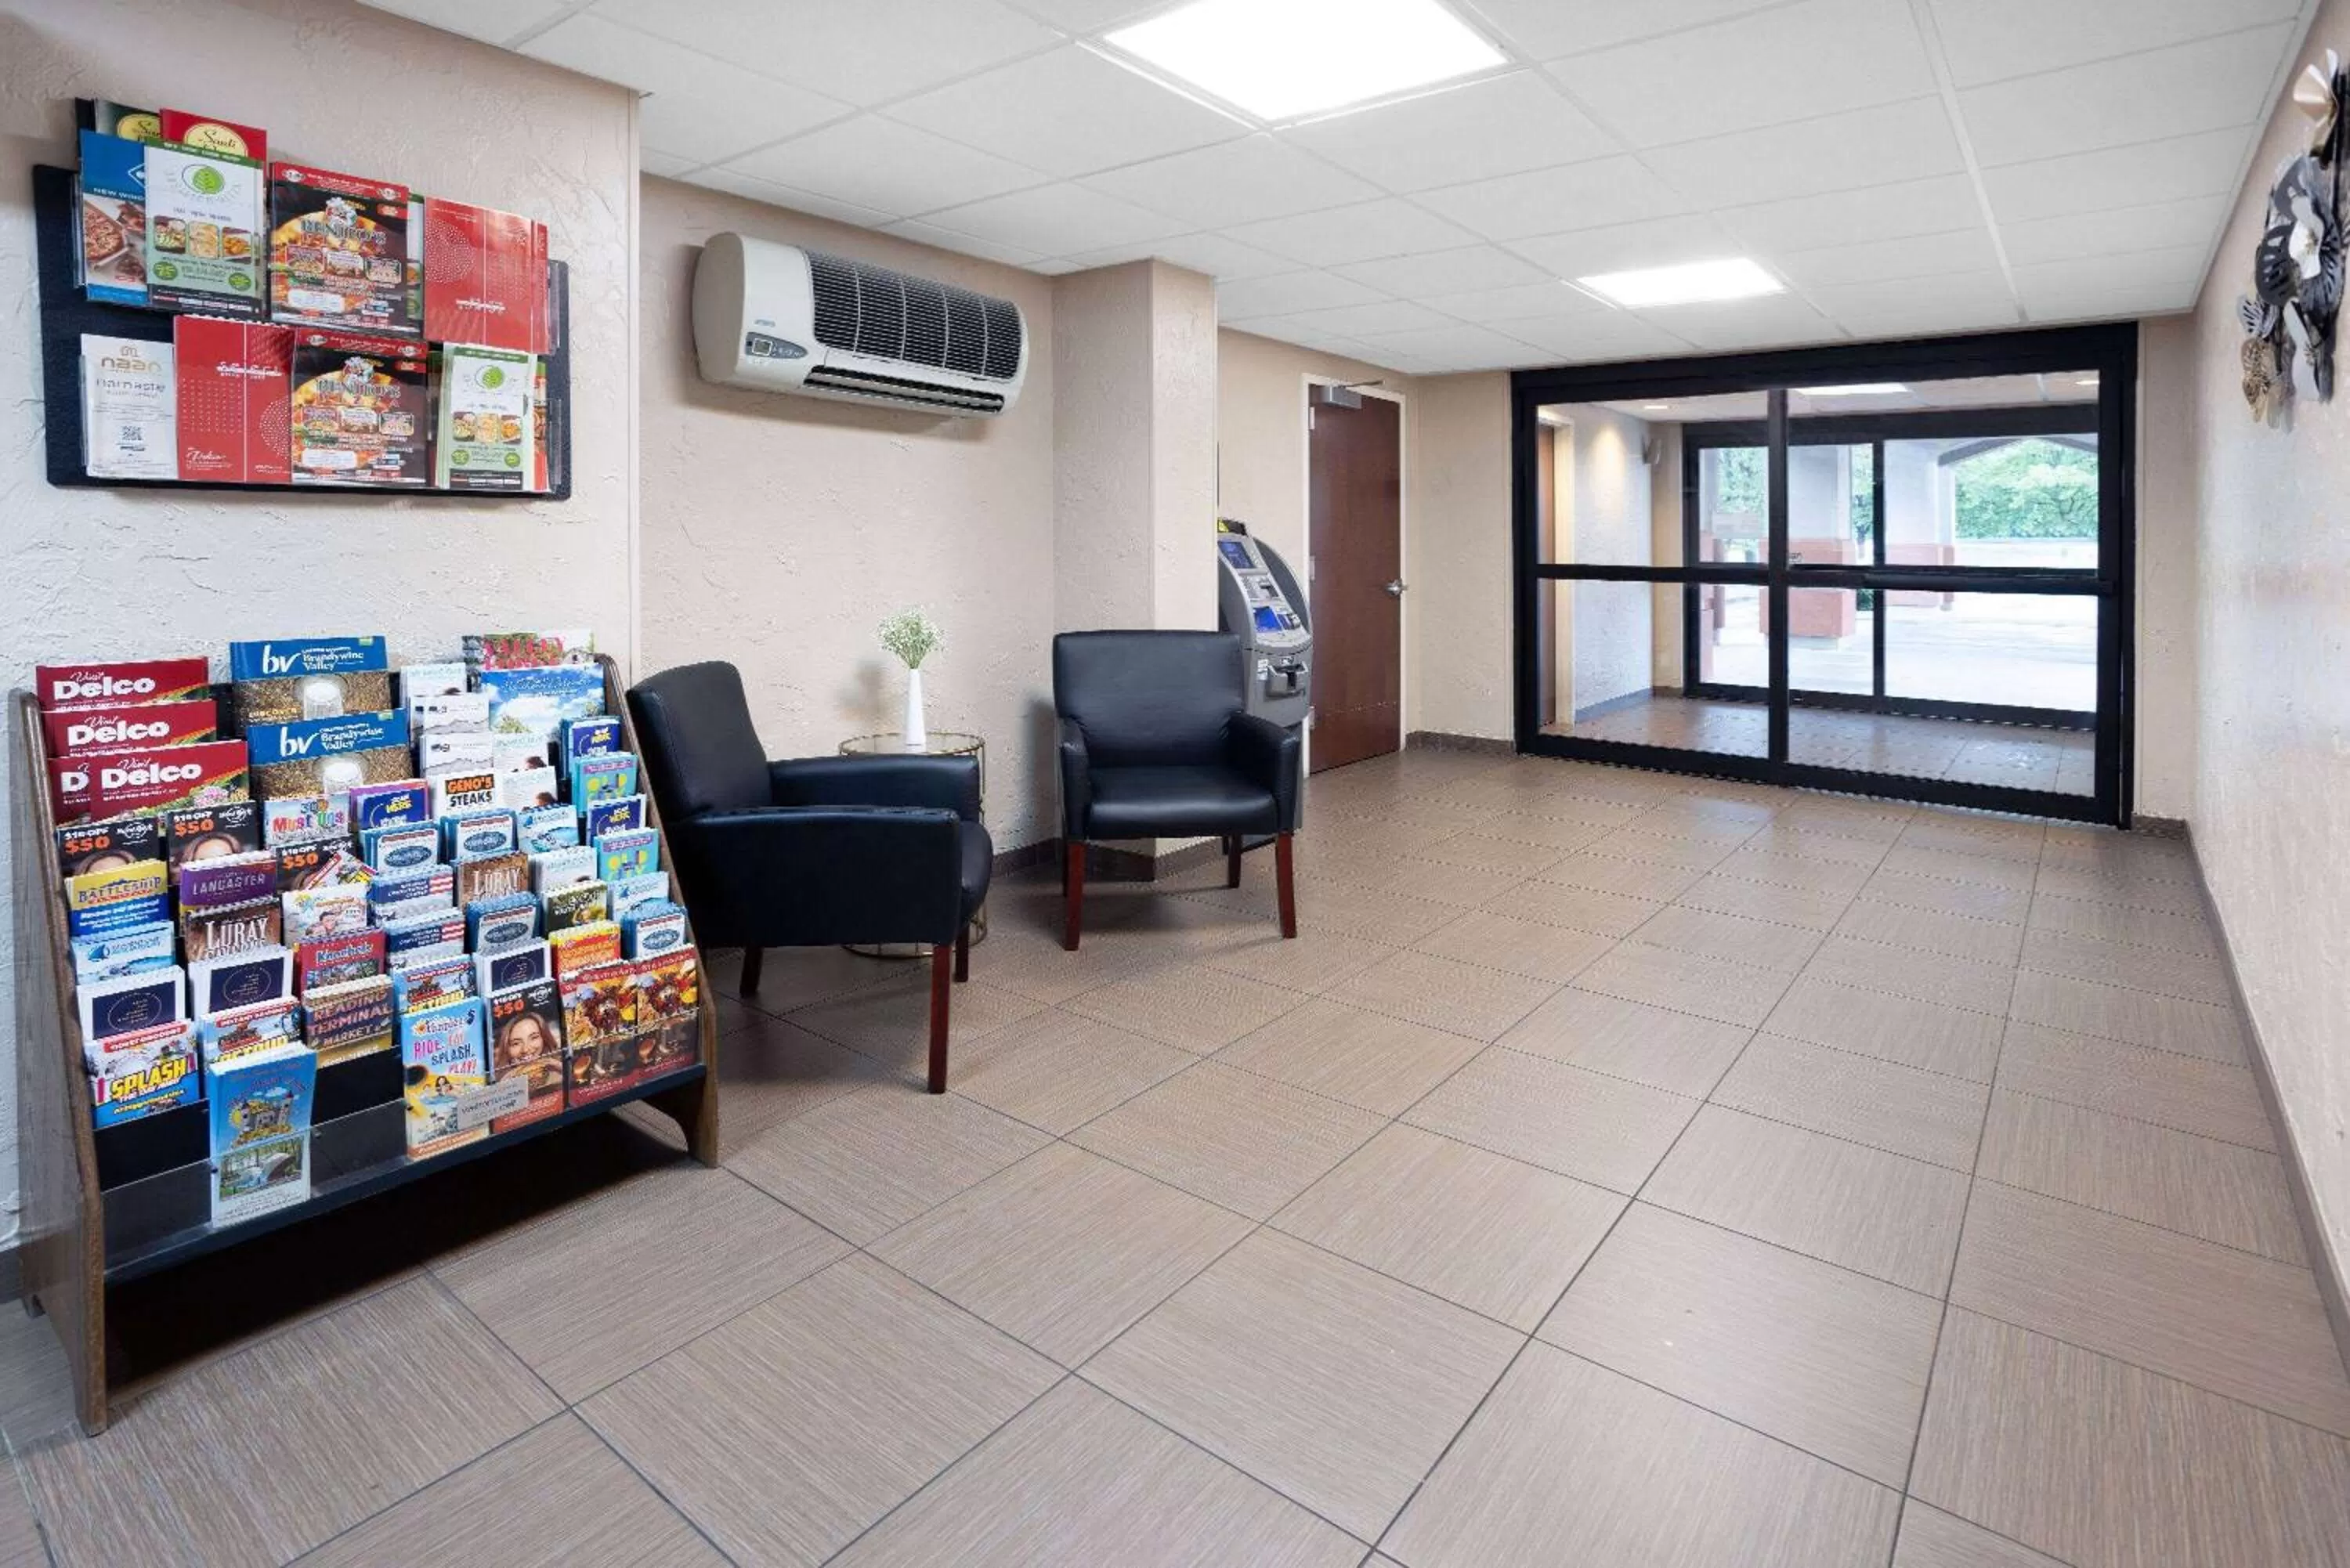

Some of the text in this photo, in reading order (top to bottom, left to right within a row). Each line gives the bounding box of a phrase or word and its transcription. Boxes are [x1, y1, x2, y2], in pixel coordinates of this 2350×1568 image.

[101, 357, 162, 373] naan
[262, 645, 302, 674] bv
[302, 652, 364, 666] Brandywine
[302, 659, 337, 671] Valley
[53, 676, 155, 699] Delco
[67, 720, 170, 746] Delco
[280, 727, 320, 757] bv
[320, 727, 383, 742] Brandywine
[320, 739, 354, 751] Valley
[117, 758, 151, 770] Visit
[101, 763, 202, 789] Delco
[447, 774, 494, 793] GENO'S
[450, 791, 493, 807] STEAKS
[175, 818, 214, 837] $50
[65, 836, 111, 854] $50
[79, 877, 161, 903] BATTLESHIP
[193, 873, 266, 895] LANCASTER
[205, 917, 268, 949] LURAY
[315, 992, 387, 1019] READING
[494, 999, 526, 1018] $50
[307, 1003, 392, 1035] TERMINAL
[324, 1024, 373, 1046] MARKET
[111, 1056, 187, 1100] SPLASH
